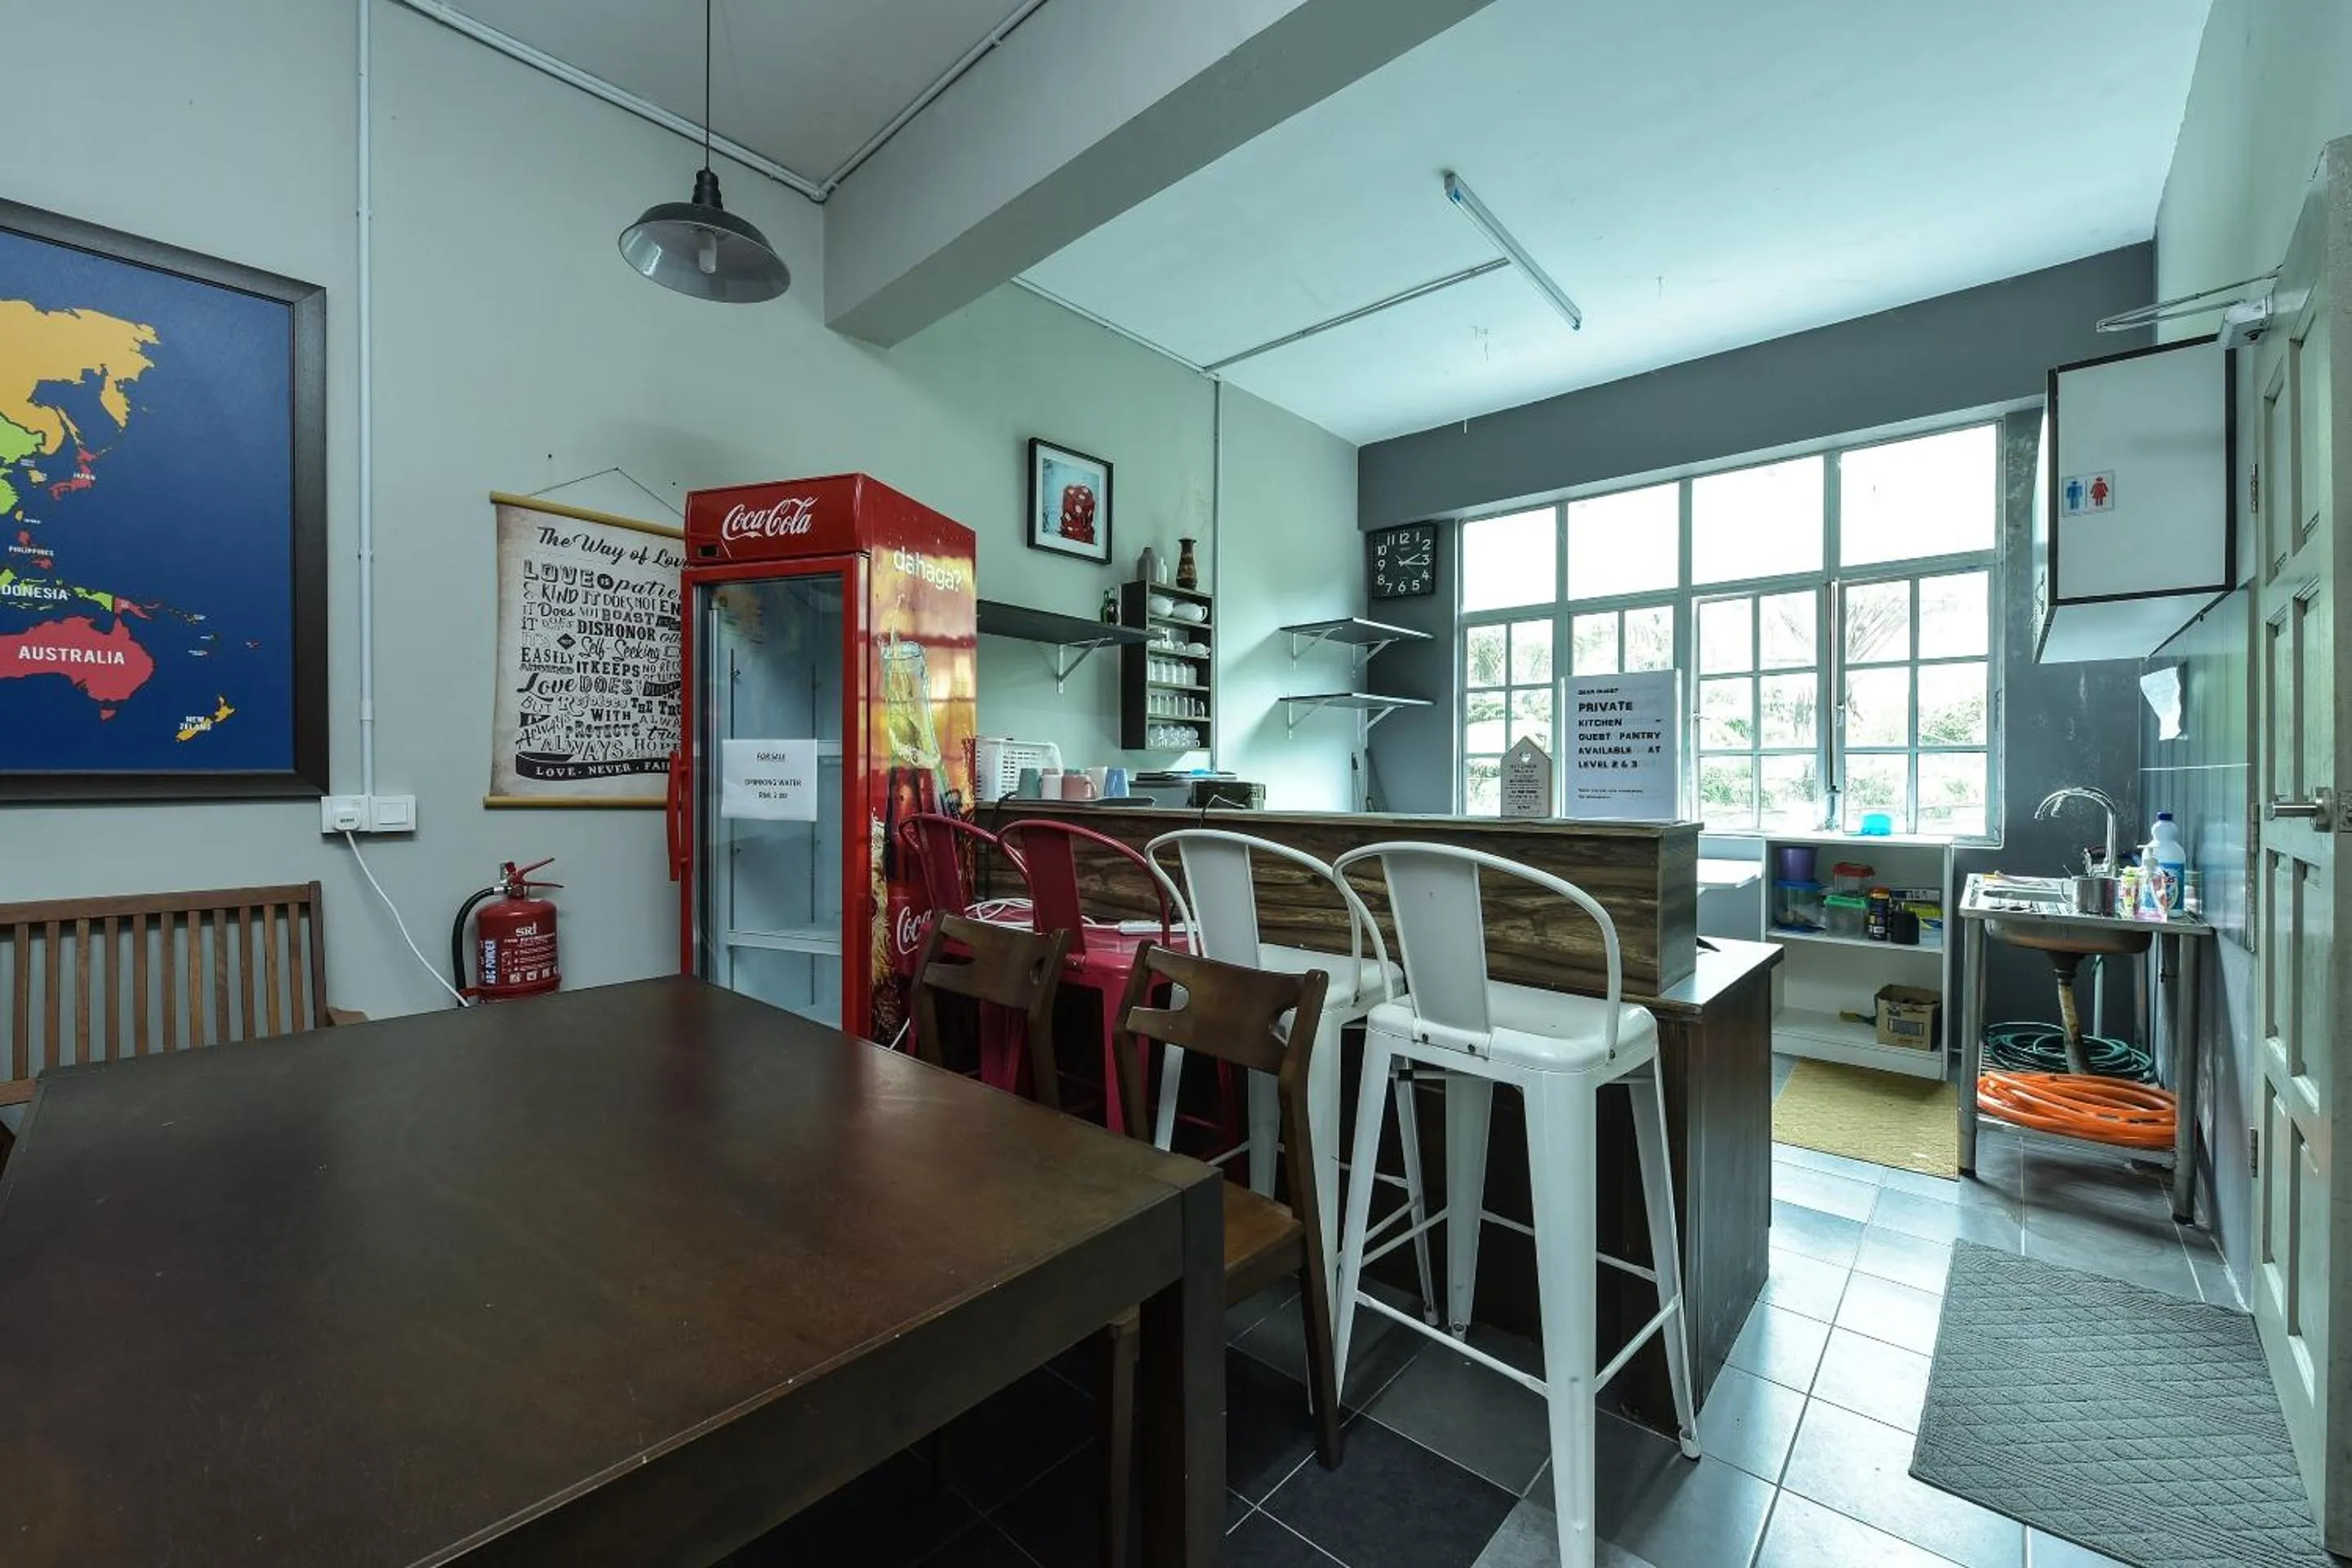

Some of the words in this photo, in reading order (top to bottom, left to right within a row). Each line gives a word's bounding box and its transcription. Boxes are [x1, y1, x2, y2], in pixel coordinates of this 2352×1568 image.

[722, 497, 819, 541] Coca-Cola
[537, 527, 570, 548] The
[572, 532, 626, 566] Way
[630, 546, 652, 565] of
[1400, 532, 1410, 545] 12
[1378, 545, 1387, 555] 10
[1422, 539, 1431, 550] 2
[893, 545, 962, 592] dahaga?
[1378, 559, 1385, 571] 9
[1422, 555, 1430, 565] 3
[523, 559, 595, 588] LOVE
[613, 578, 681, 599] patie
[1378, 573, 1385, 585] 8
[1422, 569, 1429, 581] 4
[1385, 582, 1392, 592] 7
[1398, 581, 1405, 592] 6
[1412, 580, 1419, 590] 5
[541, 584, 579, 604] KIND
[603, 594, 634, 614] DOES
[660, 599, 681, 617] EN
[537, 602, 576, 617] Does
[601, 608, 655, 626] BOAST
[577, 619, 656, 642] DISHONOR
[18, 645, 125, 666] AUSTRALIA
[521, 648, 575, 663] EASILY
[590, 661, 641, 677] KEEPS
[516, 672, 577, 702] Love
[579, 675, 634, 694] DOES
[1578, 701, 1633, 712] PRIVATE
[590, 708, 631, 722] WITH
[1578, 718, 1622, 727] KITCHEN
[1578, 733, 1610, 741] GUEST
[1619, 732, 1661, 740] PANTRY
[541, 735, 625, 761] ALWAYS
[1578, 746, 1632, 755] AVAILABLE
[1578, 760, 1607, 768] LEVEL
[1632, 760, 1638, 768] 3
